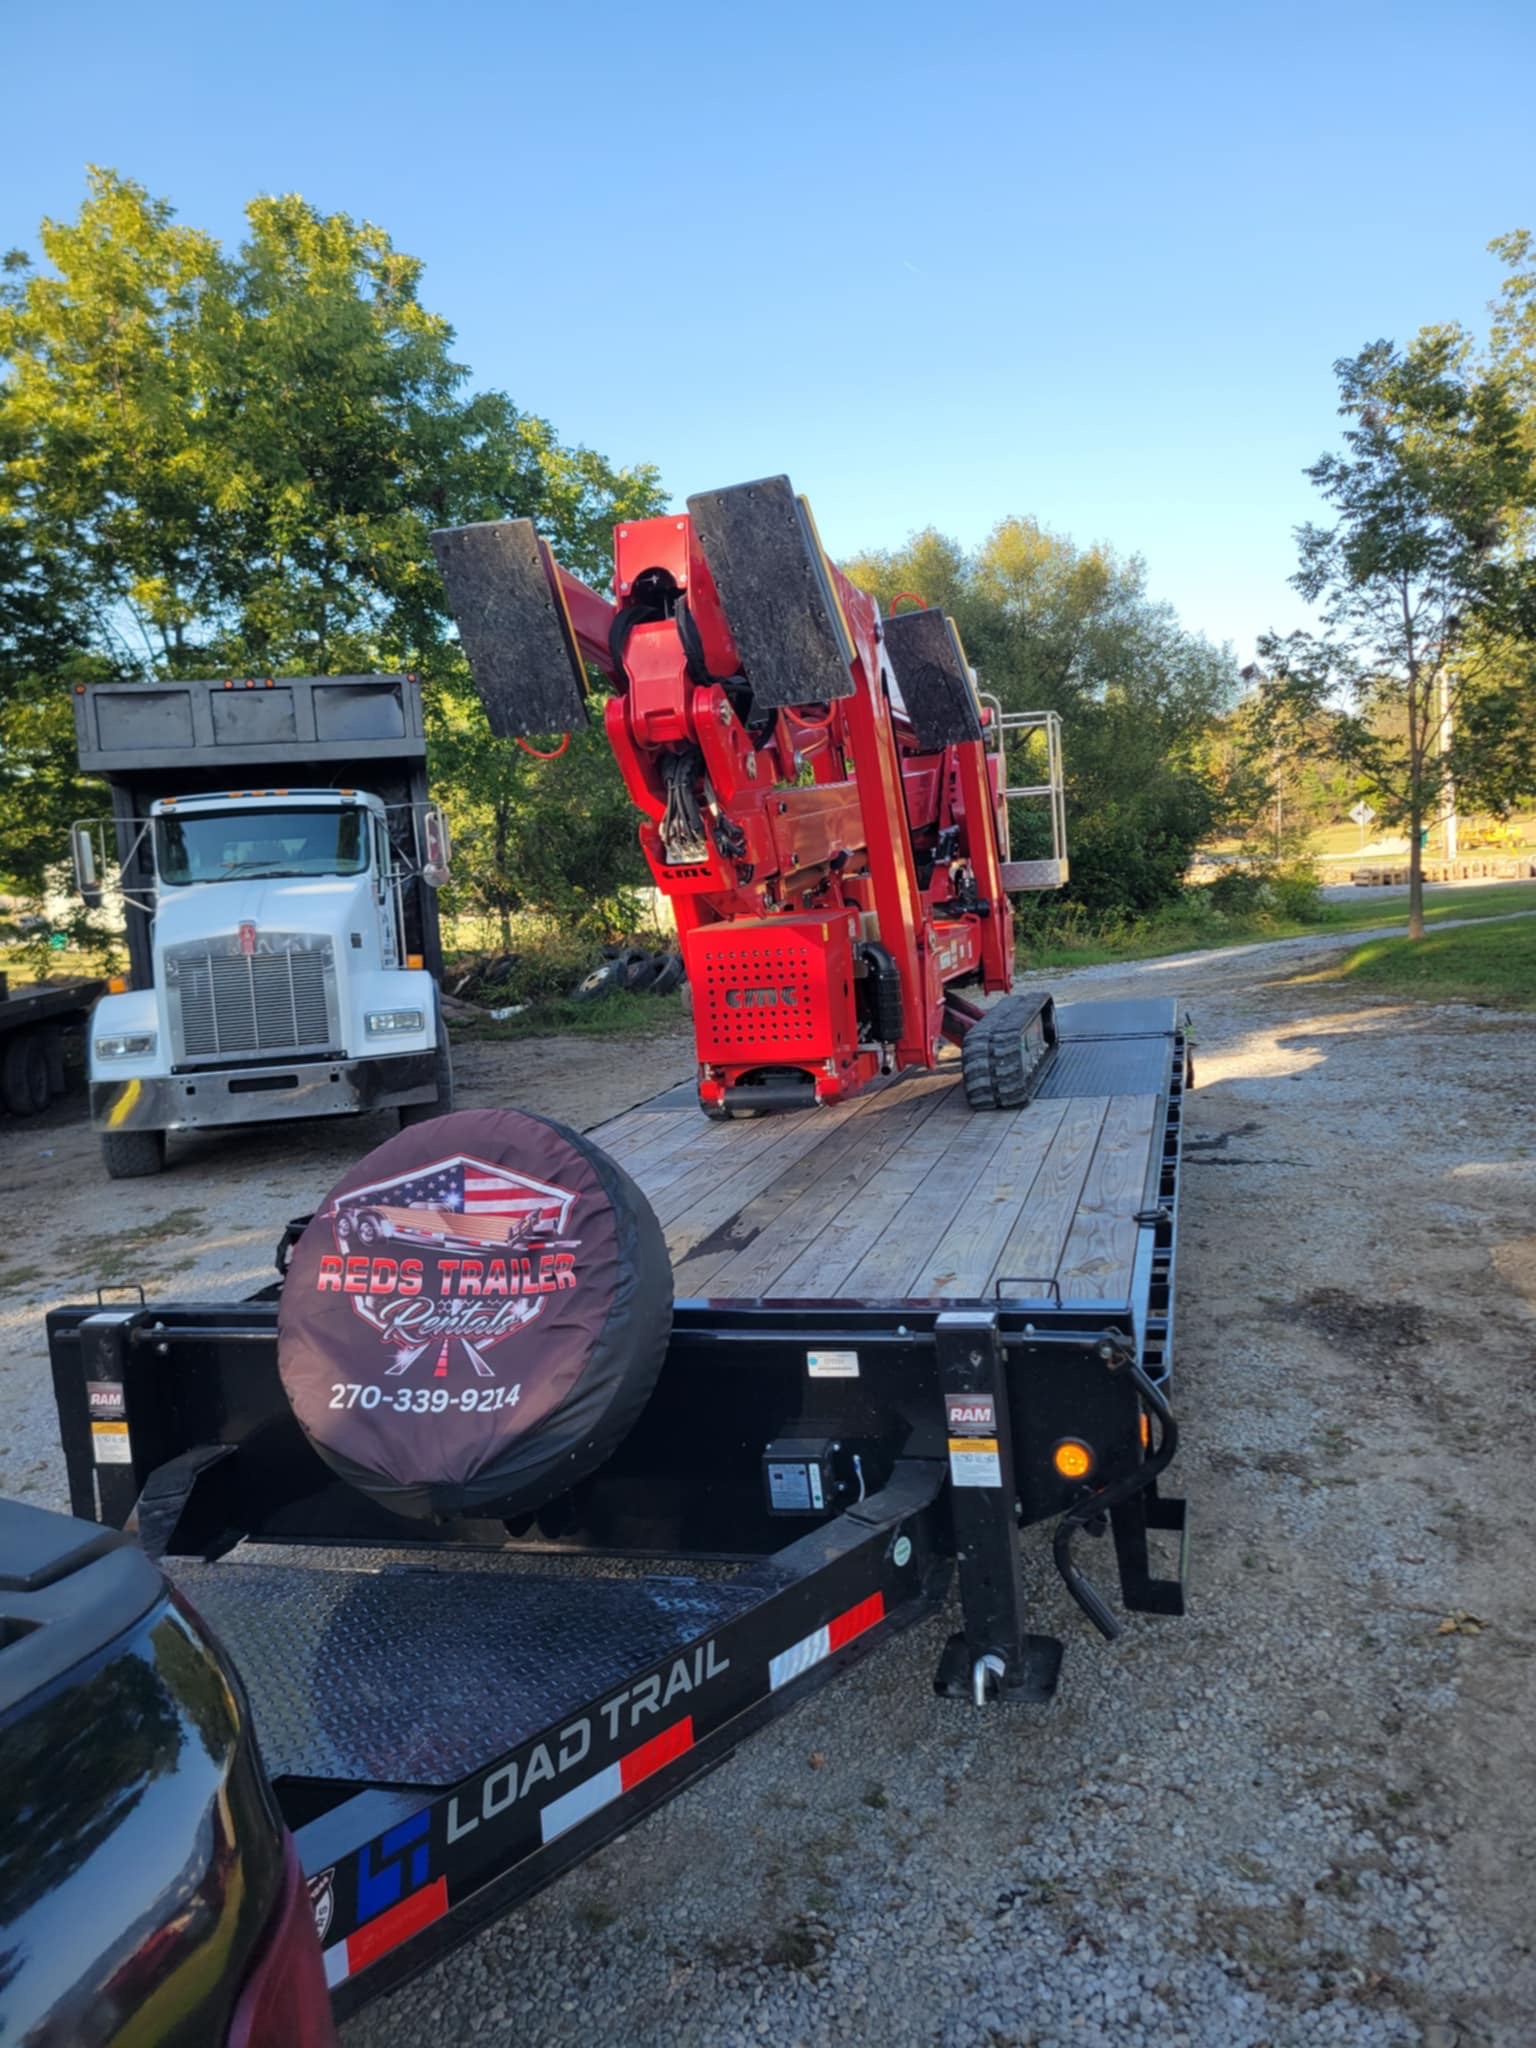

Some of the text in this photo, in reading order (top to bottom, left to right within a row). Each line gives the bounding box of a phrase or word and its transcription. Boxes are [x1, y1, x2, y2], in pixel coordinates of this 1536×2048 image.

[316, 1253, 577, 1295] REDS TRAILER
[380, 1297, 520, 1344] Rentals
[90, 1393, 121, 1406] RAM
[328, 1383, 522, 1413] 270-339-9214
[950, 1408, 991, 1422] RAM
[446, 1640, 730, 1845] LOAD TRAIL
